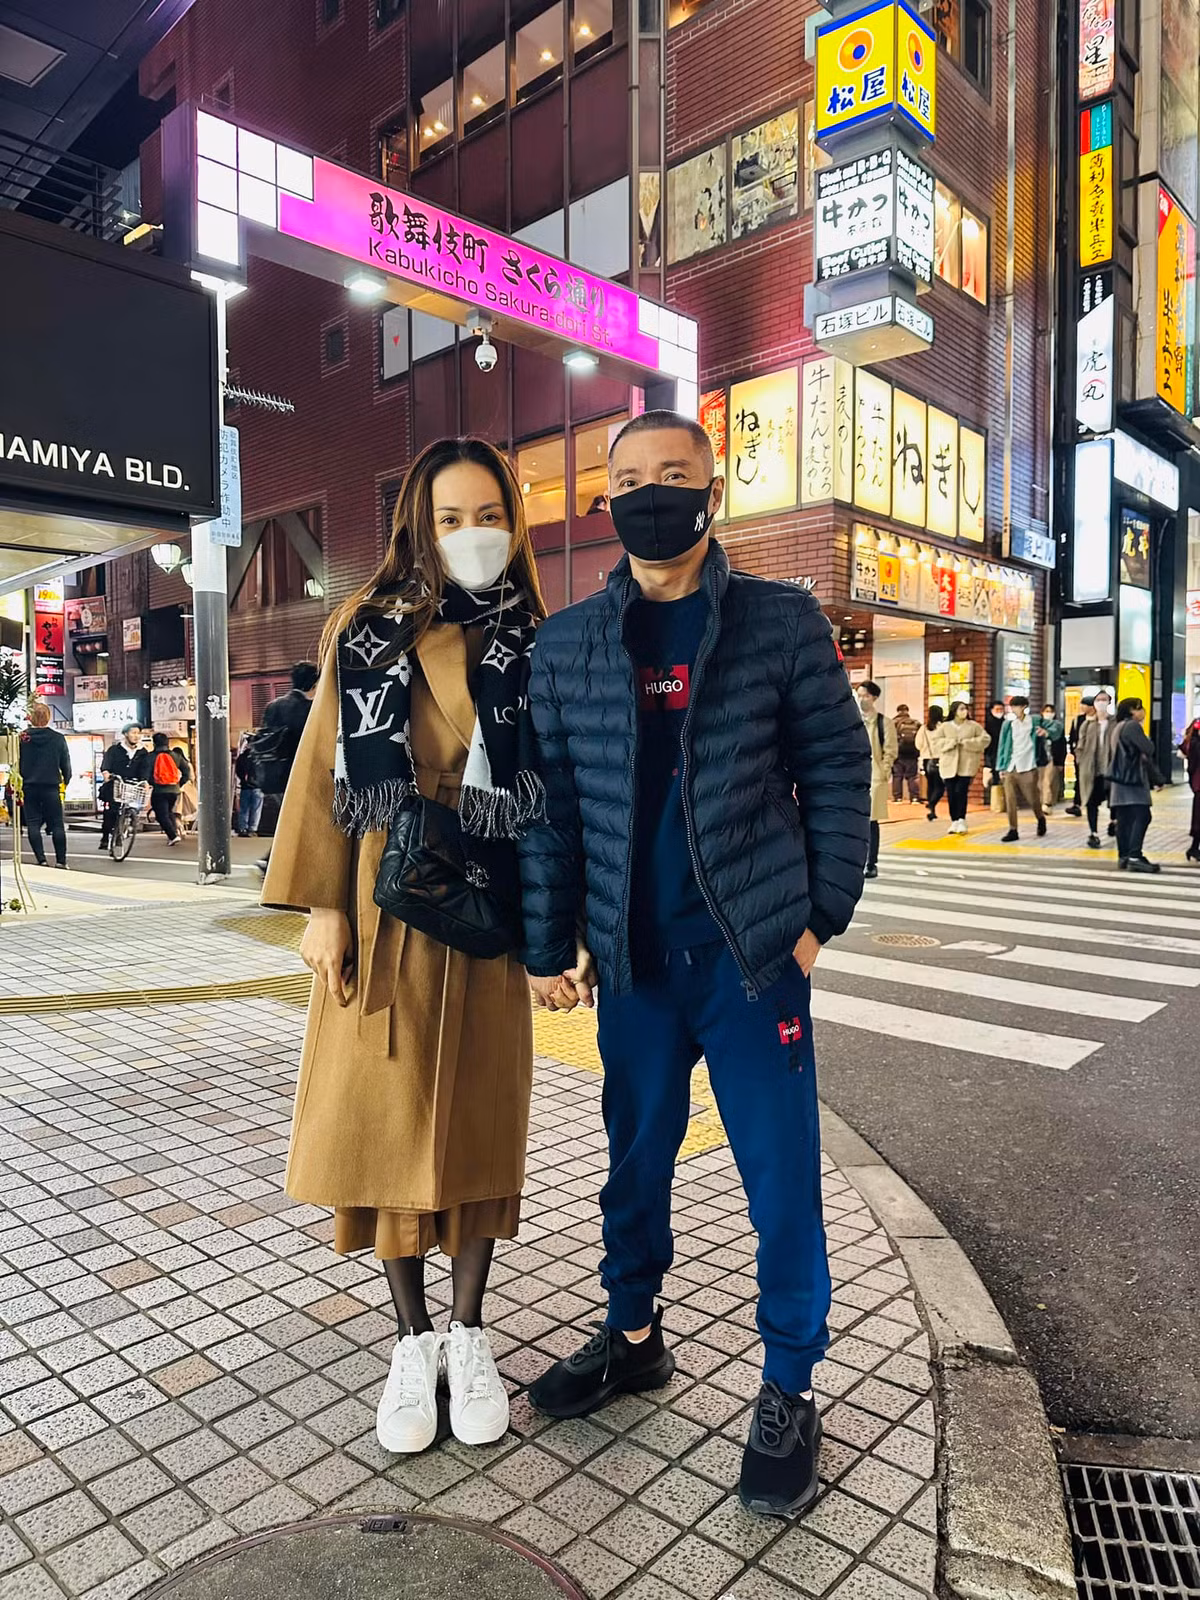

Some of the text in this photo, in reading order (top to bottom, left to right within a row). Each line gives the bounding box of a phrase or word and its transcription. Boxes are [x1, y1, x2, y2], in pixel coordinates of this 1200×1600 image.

[827, 67, 885, 113] 松屋
[902, 71, 930, 120] 松屋
[823, 193, 888, 228] 牛かつ
[369, 192, 606, 319] 歌舞伎町 さくら通り
[369, 237, 614, 348] Kabukicho Sakura-dori St.
[821, 304, 888, 334] 石塚ビル
[1081, 350, 1107, 402] 虎丸
[808, 364, 830, 440] 牛たん
[0, 433, 190, 491] AMIYA BLD.
[733, 407, 761, 485] ねぎし
[645, 680, 683, 695] HUGO
[782, 1025, 800, 1036] HUGO
